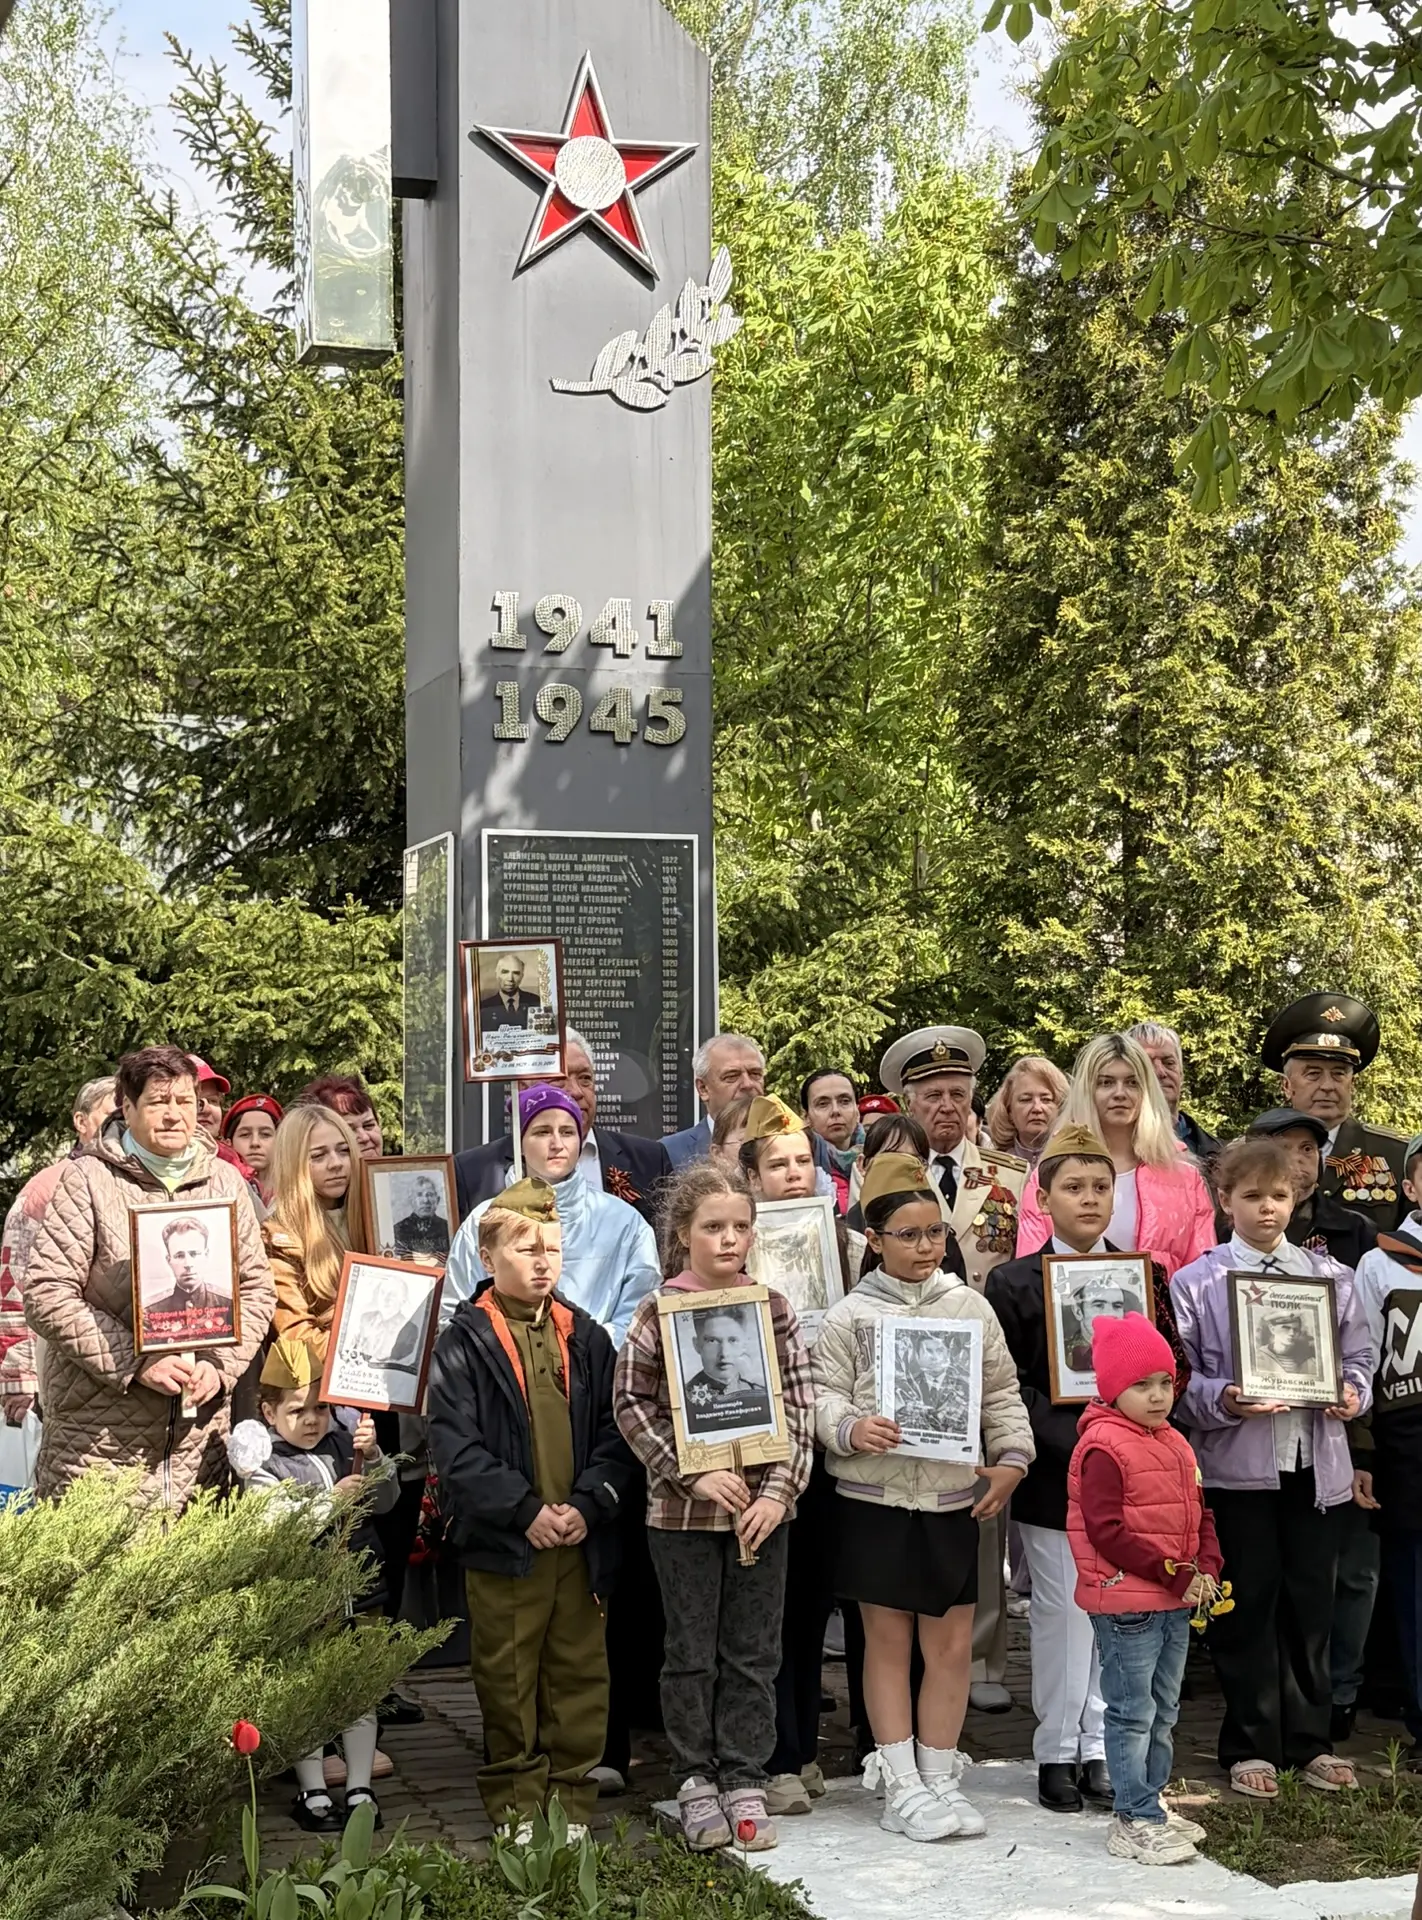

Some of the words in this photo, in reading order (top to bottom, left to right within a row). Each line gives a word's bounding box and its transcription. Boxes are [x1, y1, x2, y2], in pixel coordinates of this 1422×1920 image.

[491, 591, 683, 657] 1941
[493, 681, 686, 744] 1945
[548, 853, 578, 861] МИХАИЛ
[581, 854, 628, 863] ДМИТРИЕВИЧ
[543, 863, 571, 872] АНДРЕЙ
[574, 864, 610, 872] ИВАНОВИЧ
[552, 873, 584, 881] ВАСИЛИЙ
[588, 874, 627, 883] АНДРЕЕВИЧ
[552, 883, 577, 892] СЕРГЕЙ
[581, 885, 617, 893] ИВАНОВИЧ
[552, 894, 580, 903] АНДРЕЙ
[583, 895, 627, 904] СТЕПАНОВИЧ
[556, 905, 575, 913] ИВАН
[556, 916, 575, 924] ИВАН
[579, 917, 616, 925] ЕГОРОВИЧ
[556, 925, 582, 934] СЕРГЕЙ
[586, 927, 624, 935] ЕГОРОВИЧ
[575, 937, 622, 946] ВАСИЛЬЕВИЧ
[569, 948, 606, 956] ПЕТРОВИЧ
[563, 957, 595, 966] АЛЕКСЕЙ
[599, 958, 639, 967] СЕРГЕЕВИЧ
[600, 969, 640, 977] СЕРГЕЕВИЧ
[586, 980, 626, 988] СЕРГЕЕВИЧ
[585, 990, 625, 998] СЕРГЕЕВИЧ
[575, 1021, 619, 1029] СЕМЕНОВИЧ
[595, 1115, 638, 1123] АСИЛЬЕВИЧ
[1270, 1300, 1301, 1310] ПОЛК
